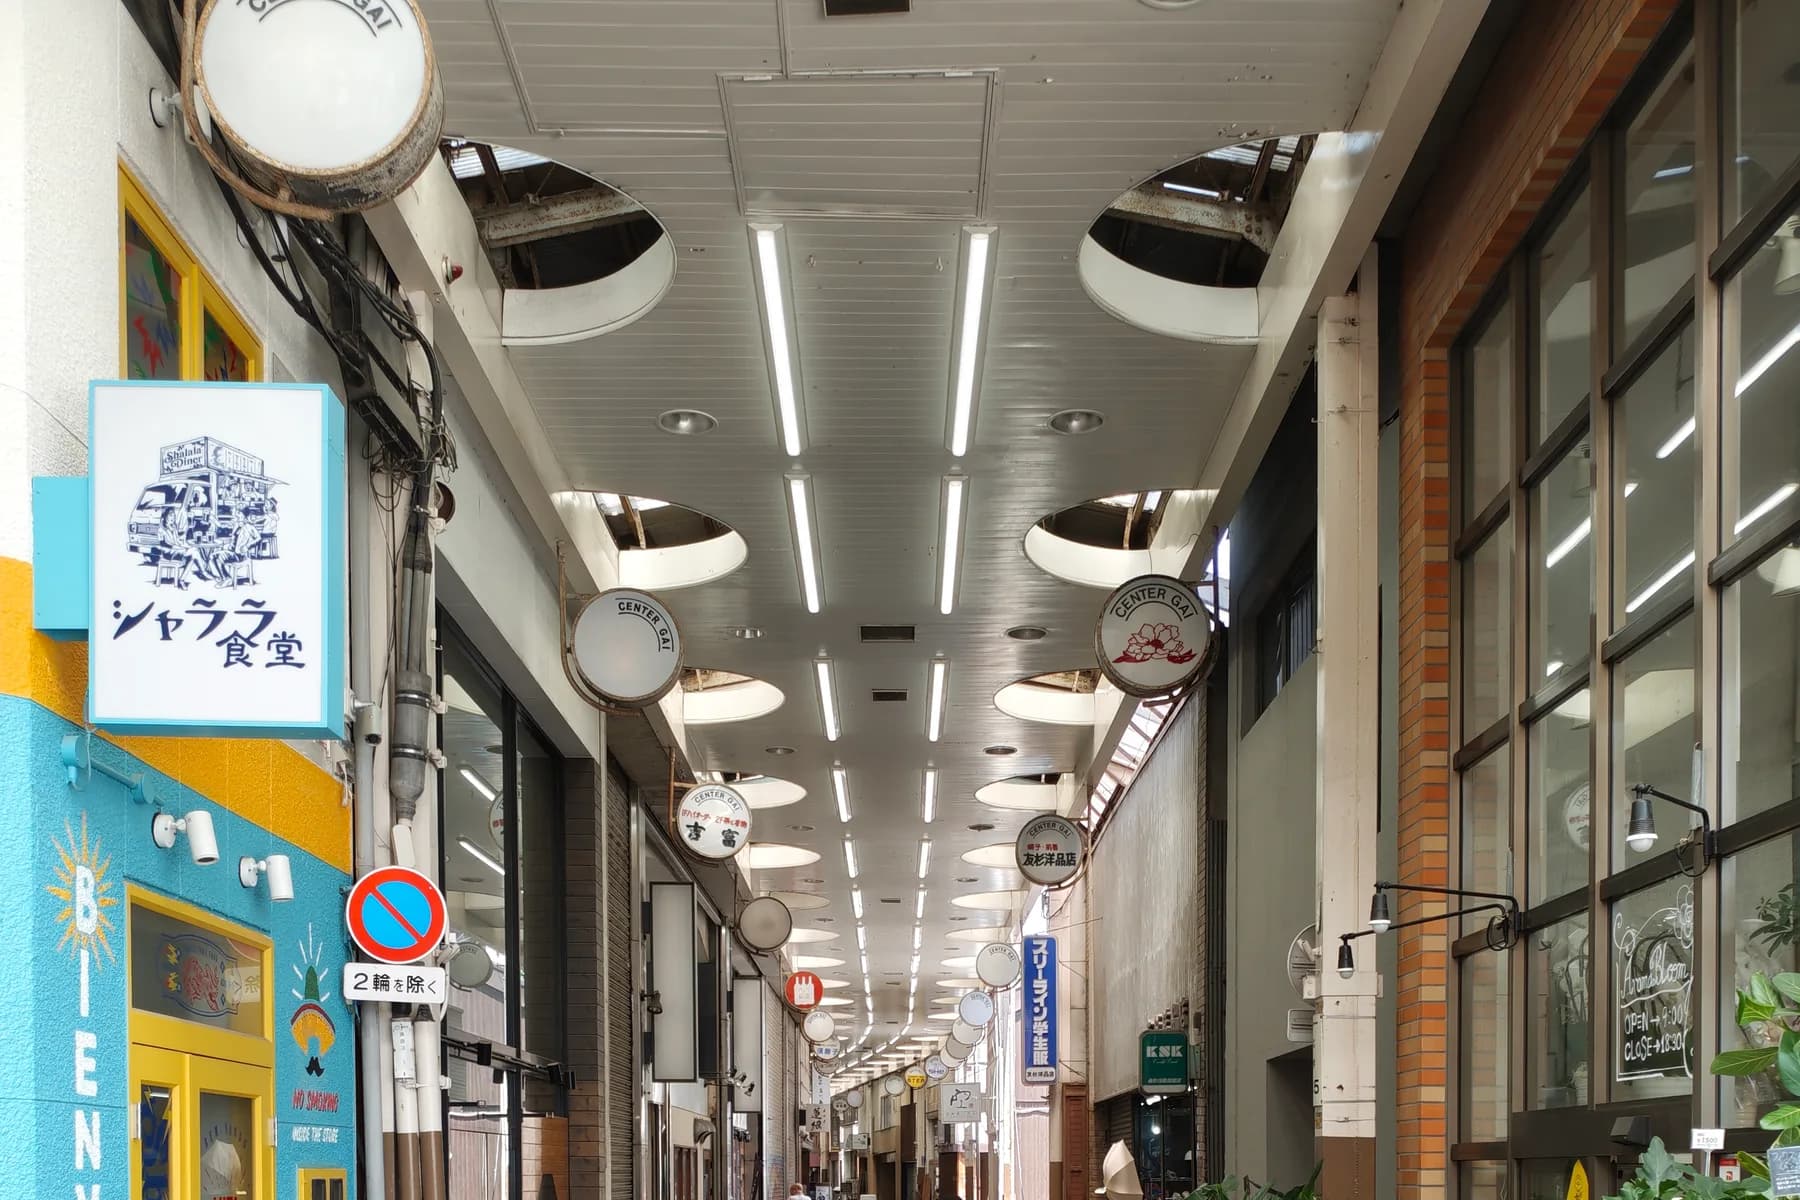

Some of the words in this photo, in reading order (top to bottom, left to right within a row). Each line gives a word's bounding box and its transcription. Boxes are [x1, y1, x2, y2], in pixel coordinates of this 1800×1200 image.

[1115, 587, 1167, 618] CENTER
[1171, 595, 1194, 619] GAI
[113, 598, 277, 641] シャララ
[618, 602, 660, 625] CENTER
[659, 629, 670, 650] GAI
[215, 630, 306, 668] 食堂
[694, 791, 725, 803] CENTER
[727, 797, 740, 811] GAI
[1030, 822, 1056, 837] CENTER
[1059, 825, 1071, 837] GAI
[1022, 852, 1077, 867] 友杉洋品店
[353, 972, 437, 995] 2輪を除く
[1032, 939, 1049, 1066] スリーライン学生服
[1624, 1010, 1650, 1035] OPEN
[1146, 1045, 1183, 1057] KSK
[1624, 1035, 1653, 1062] CLOSE
[292, 1088, 305, 1110] NO
